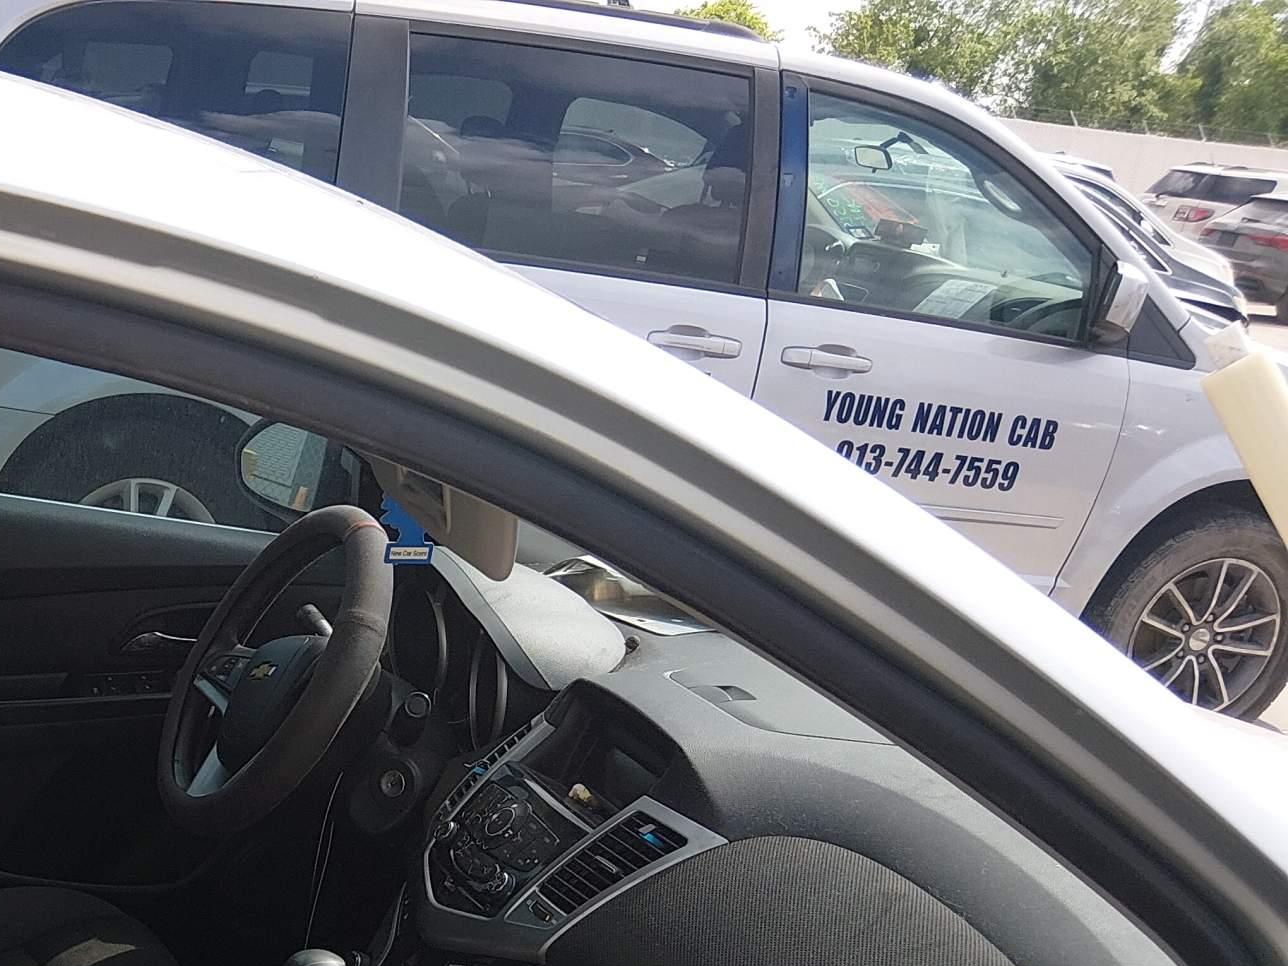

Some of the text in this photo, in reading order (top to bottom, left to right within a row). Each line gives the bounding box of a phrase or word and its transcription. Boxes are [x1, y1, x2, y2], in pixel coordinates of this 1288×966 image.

[823, 390, 1059, 450] YOUNG NATION CAB
